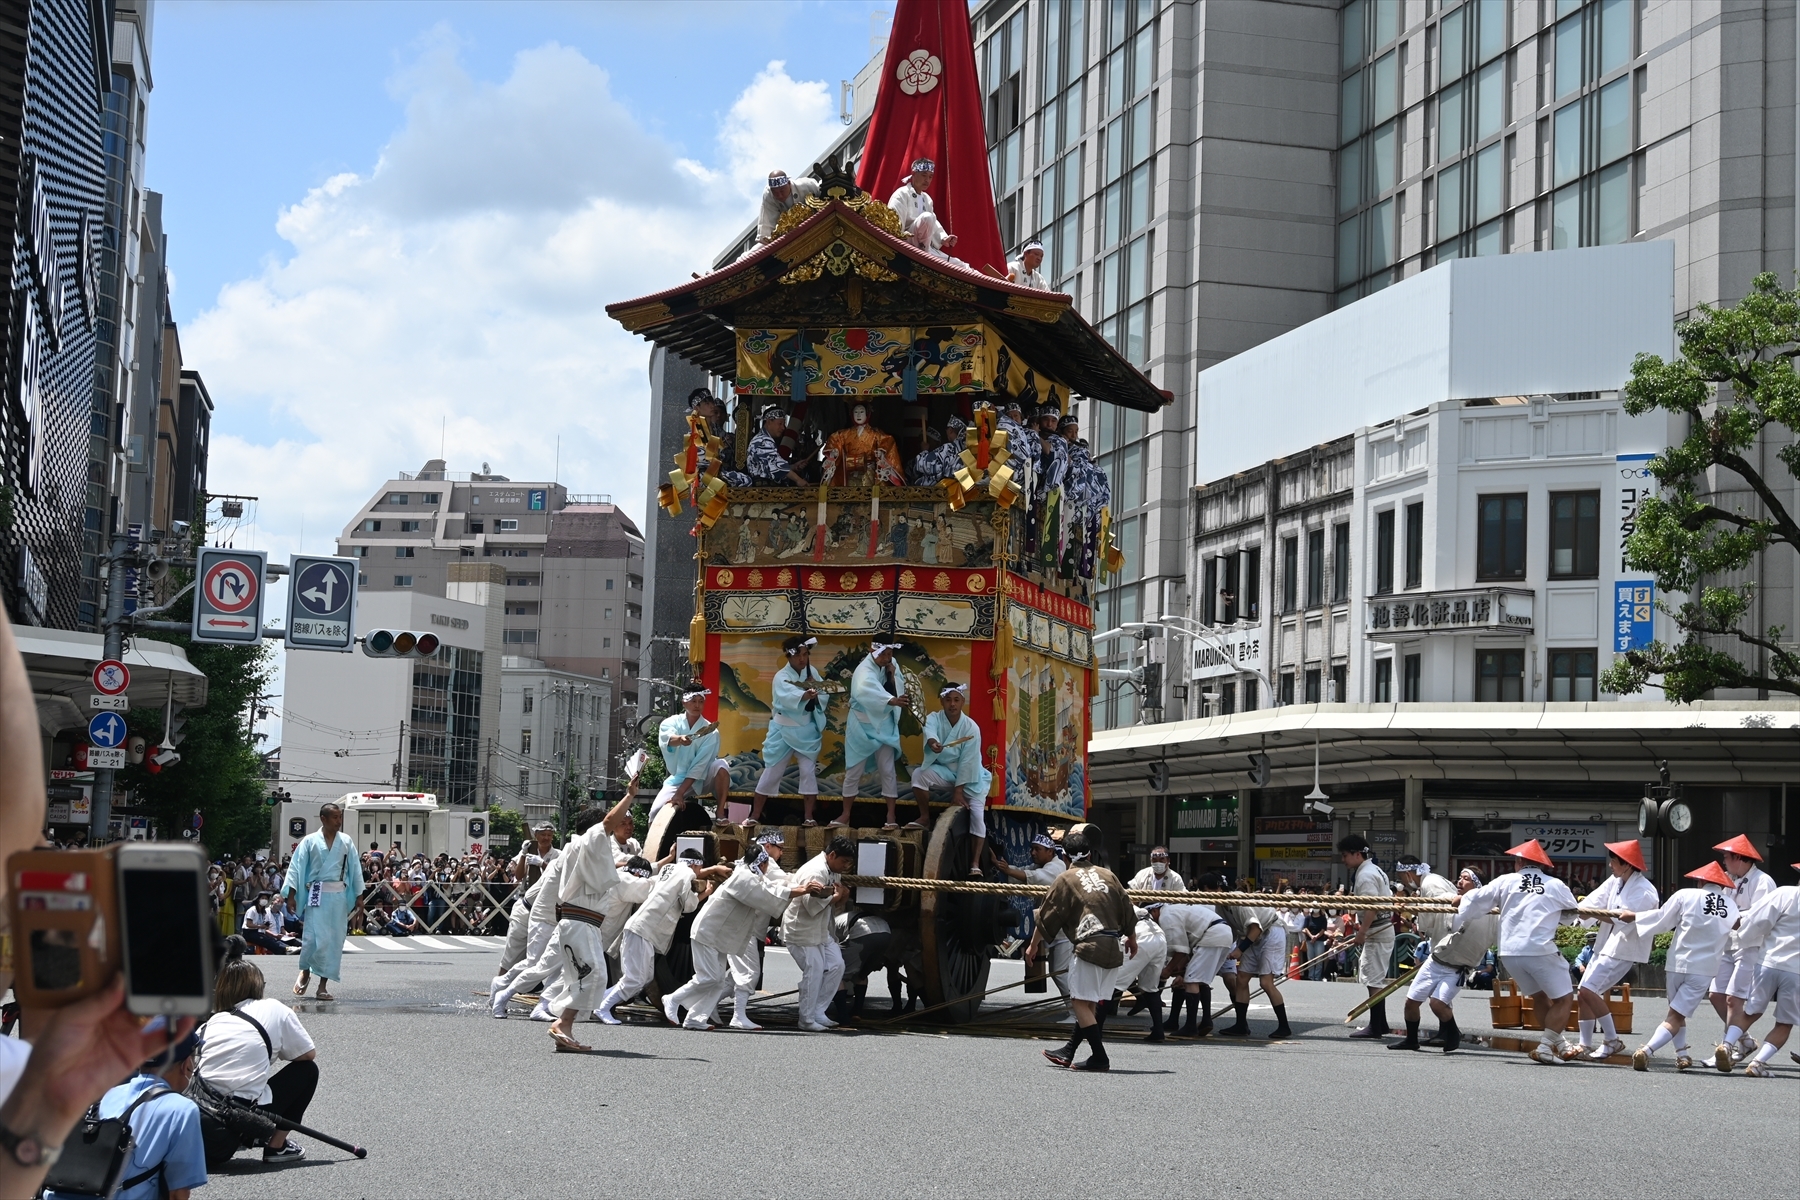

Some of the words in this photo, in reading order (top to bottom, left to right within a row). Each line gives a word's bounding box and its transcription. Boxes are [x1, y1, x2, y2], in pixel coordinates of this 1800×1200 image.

[1635, 588, 1649, 620] すぐ
[1372, 598, 1490, 629] 池善化粧品店
[1618, 587, 1633, 650] 買えます
[293, 622, 347, 637] 路線バスを除く
[1239, 639, 1259, 662] 雲の茶
[89, 749, 124, 758] 路線バスを除く
[1177, 808, 1217, 829] MARUMARU
[1264, 819, 1316, 831] アクセスチケット
[1547, 828, 1595, 836] メガネスーパー
[1270, 848, 1283, 858] Money
[1524, 839, 1595, 853] ンタクト
